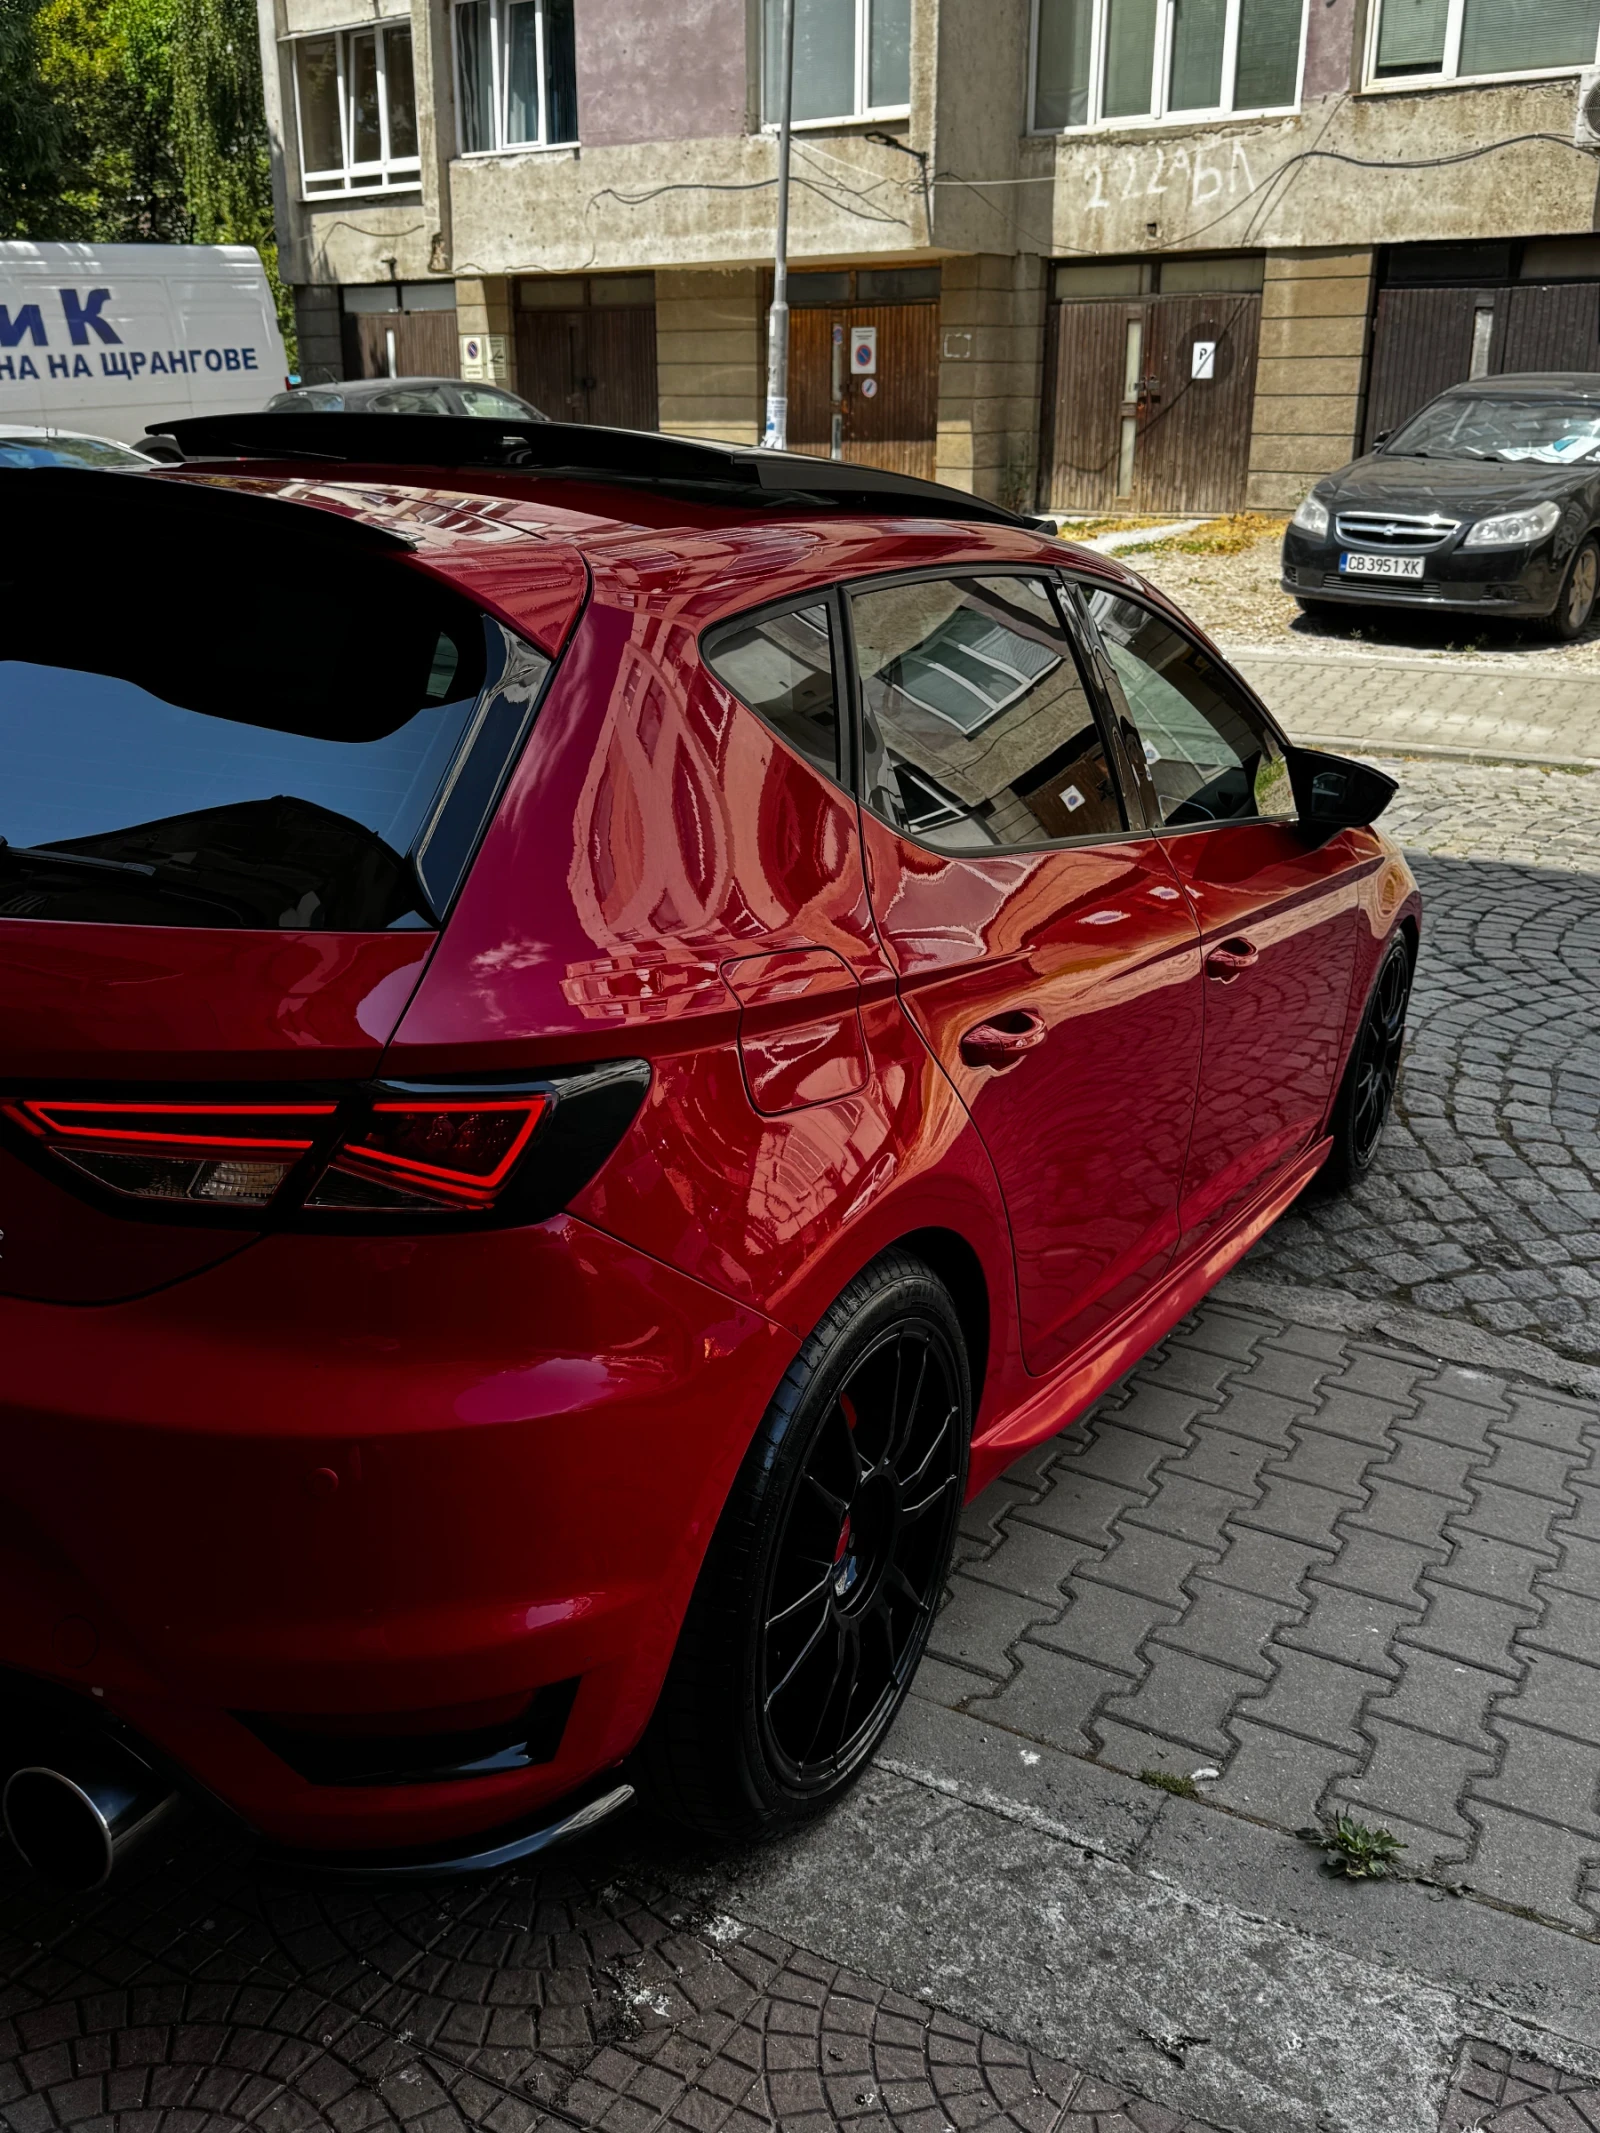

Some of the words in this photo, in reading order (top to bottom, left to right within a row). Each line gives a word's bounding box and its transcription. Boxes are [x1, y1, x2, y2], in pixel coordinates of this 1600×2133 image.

[47, 354, 93, 379] НА
[100, 348, 259, 380] ЩРАНГОВЕ
[1348, 556, 1365, 571] CB
[1367, 557, 1399, 573] 3951
[1402, 560, 1420, 575] XK
